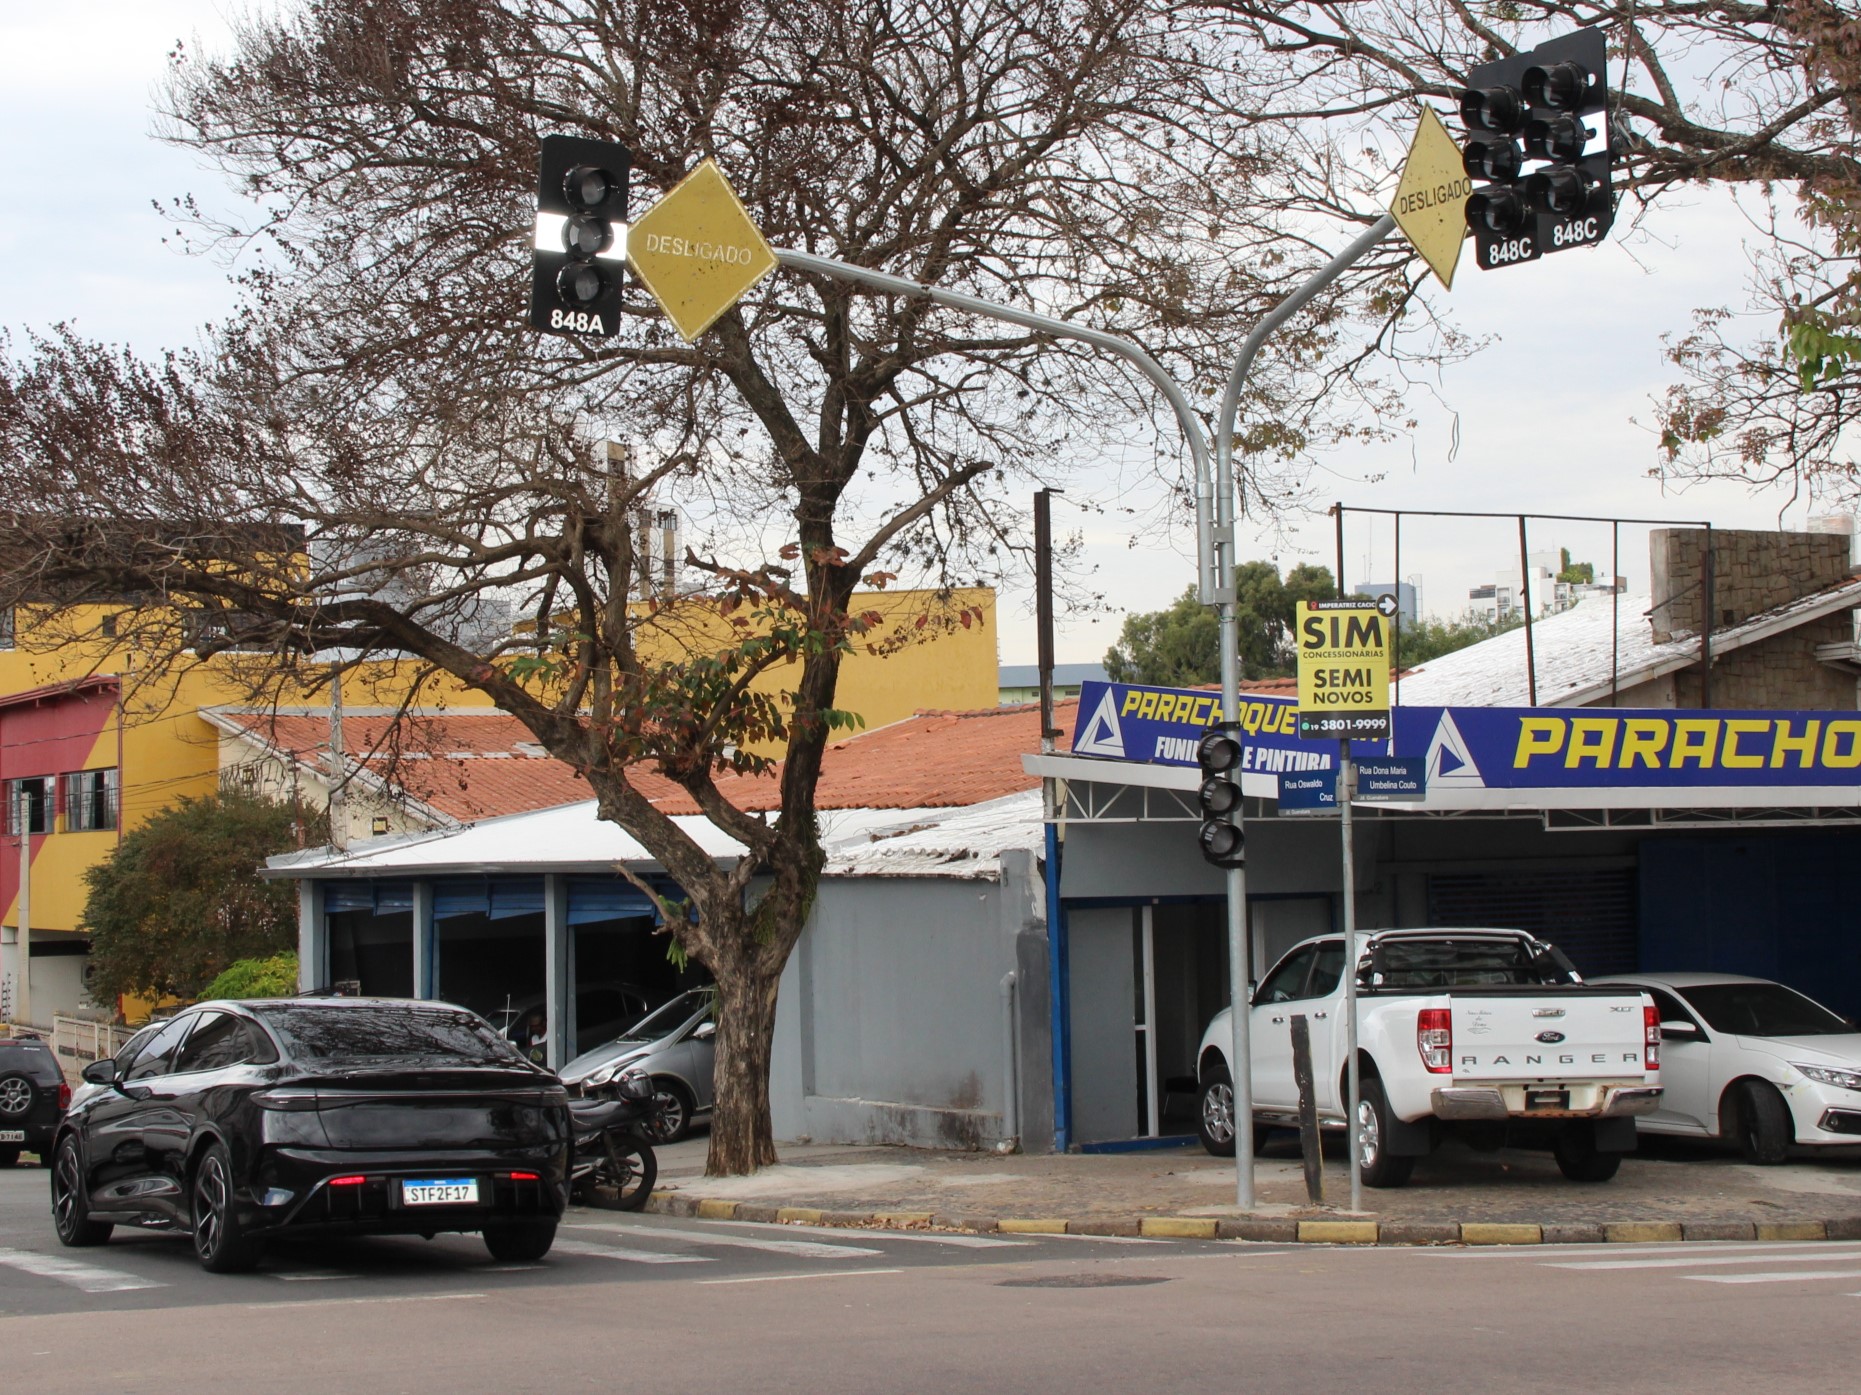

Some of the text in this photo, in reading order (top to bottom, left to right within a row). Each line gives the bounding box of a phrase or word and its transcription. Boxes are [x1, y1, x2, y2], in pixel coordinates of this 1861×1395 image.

[1400, 177, 1471, 216] DESLIGADO
[1553, 217, 1598, 246] 848C
[645, 233, 752, 265] DESLIGADO
[1489, 237, 1532, 265] 848C
[550, 308, 605, 335] 848A
[1303, 615, 1383, 650] SIM
[1303, 650, 1384, 659] CONCESSIONÁRIAS
[1314, 668, 1372, 688] SEMI
[1313, 691, 1373, 704] NOVOS
[1321, 718, 1387, 731] 3801-9999
[1242, 746, 1253, 769] E
[1359, 766, 1407, 775] Rua Dona Maria
[1285, 779, 1323, 789] Rua Oswaldo
[1369, 780, 1417, 790] Umbelina Couto
[1319, 792, 1334, 802] Cruz
[1542, 1032, 1560, 1041] Ford
[1462, 1053, 1638, 1065] RANGER
[411, 1186, 469, 1202] STF2F17
